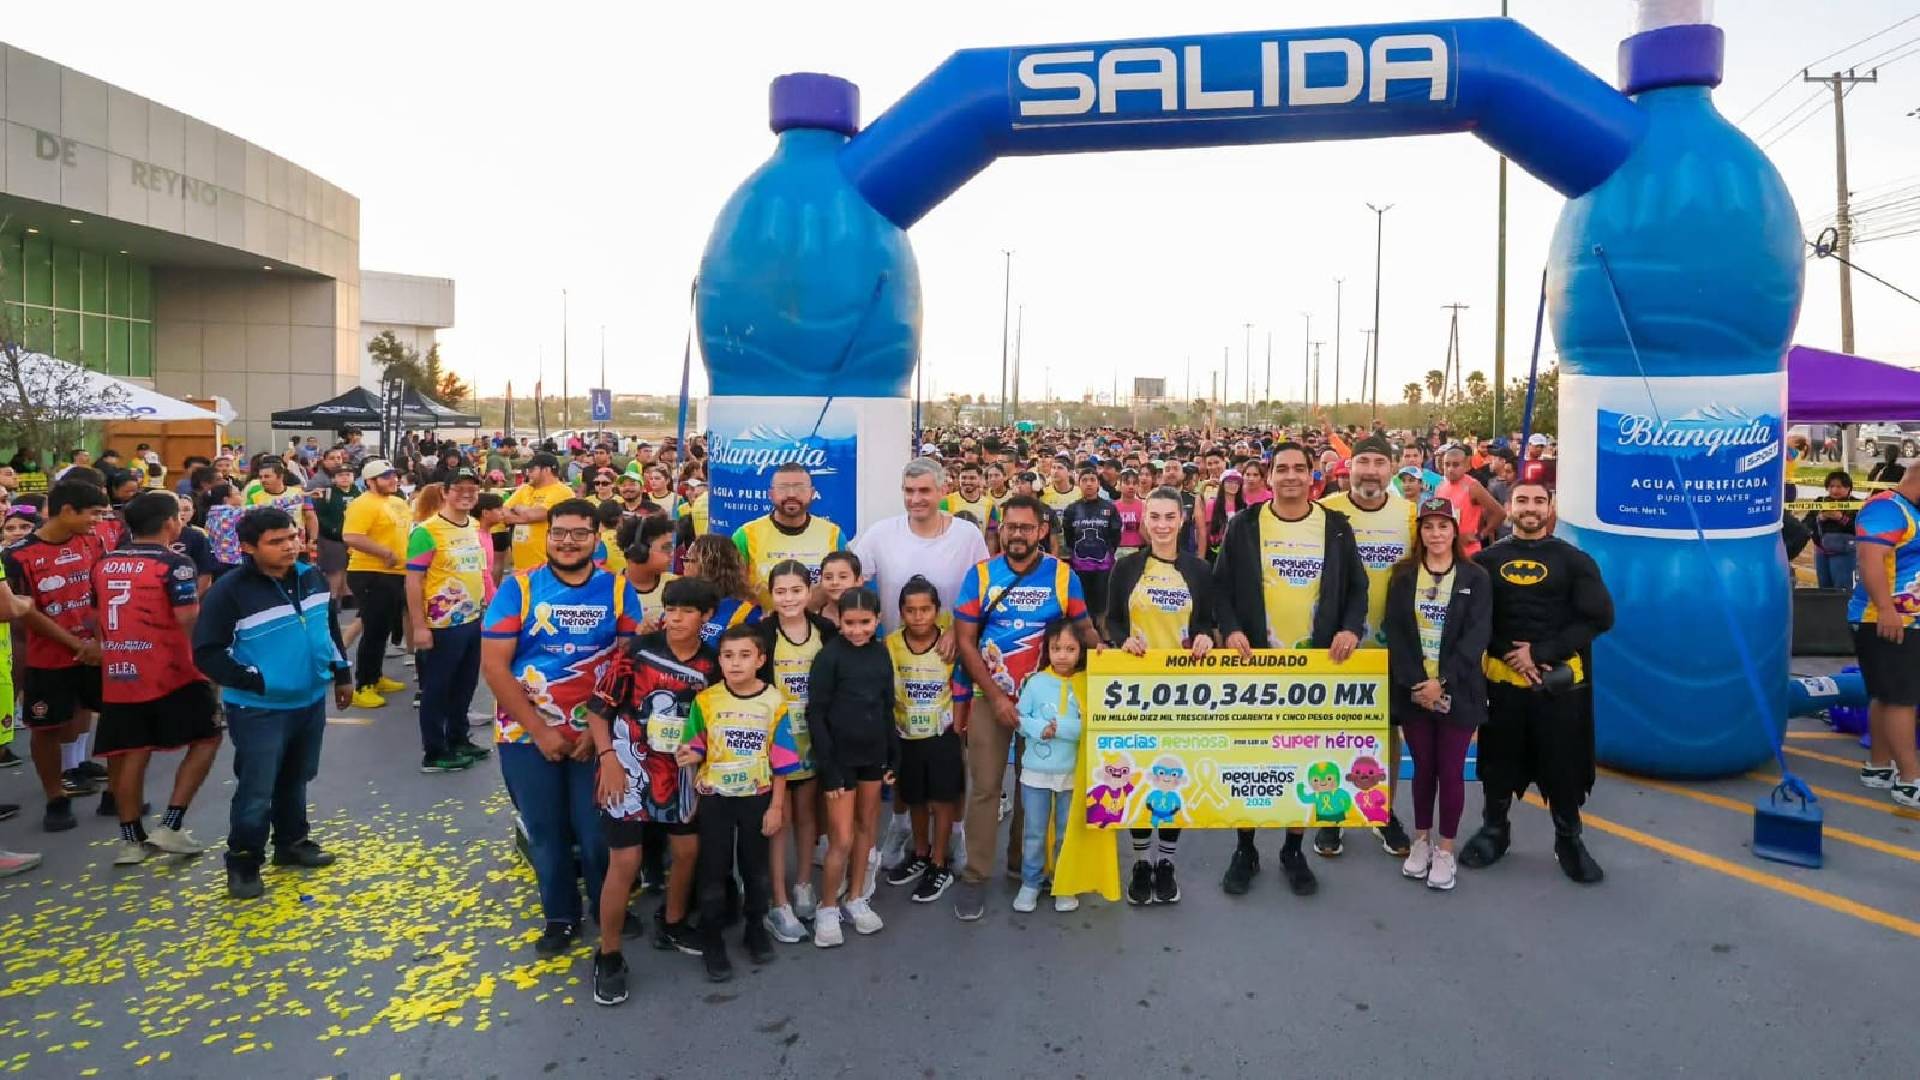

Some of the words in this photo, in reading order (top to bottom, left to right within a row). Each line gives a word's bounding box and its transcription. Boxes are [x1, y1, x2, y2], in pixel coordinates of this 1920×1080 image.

[1018, 34, 1449, 116] SALIDA
[36, 130, 77, 167] DE
[1618, 413, 1771, 457] Blanquita
[711, 434, 827, 476] Blanquita
[1632, 478, 1675, 490] AGUA
[1685, 477, 1768, 491] PURIFICADA
[1716, 493, 1749, 503] WATER
[103, 562, 134, 573] ADAN
[107, 580, 131, 630] 7
[1165, 654, 1217, 668] MONTO
[1219, 654, 1308, 668] RECAUDADO
[1103, 679, 1326, 711] $1,010,345.00
[1333, 683, 1377, 706] MX
[911, 715, 930, 725] 914
[1139, 713, 1160, 721] DIEZ
[1160, 713, 1173, 721] MIL
[1175, 713, 1230, 722] TRESCIENTOS
[1274, 713, 1281, 721] Y
[1282, 713, 1306, 721] CINCO
[1307, 713, 1334, 721] PESOS
[1097, 733, 1157, 750] gracias
[1271, 734, 1321, 749] super
[722, 771, 748, 785] 978
[1221, 769, 1295, 784] pequeños
[1231, 783, 1284, 797] héroes
[1245, 797, 1272, 807] 2026
